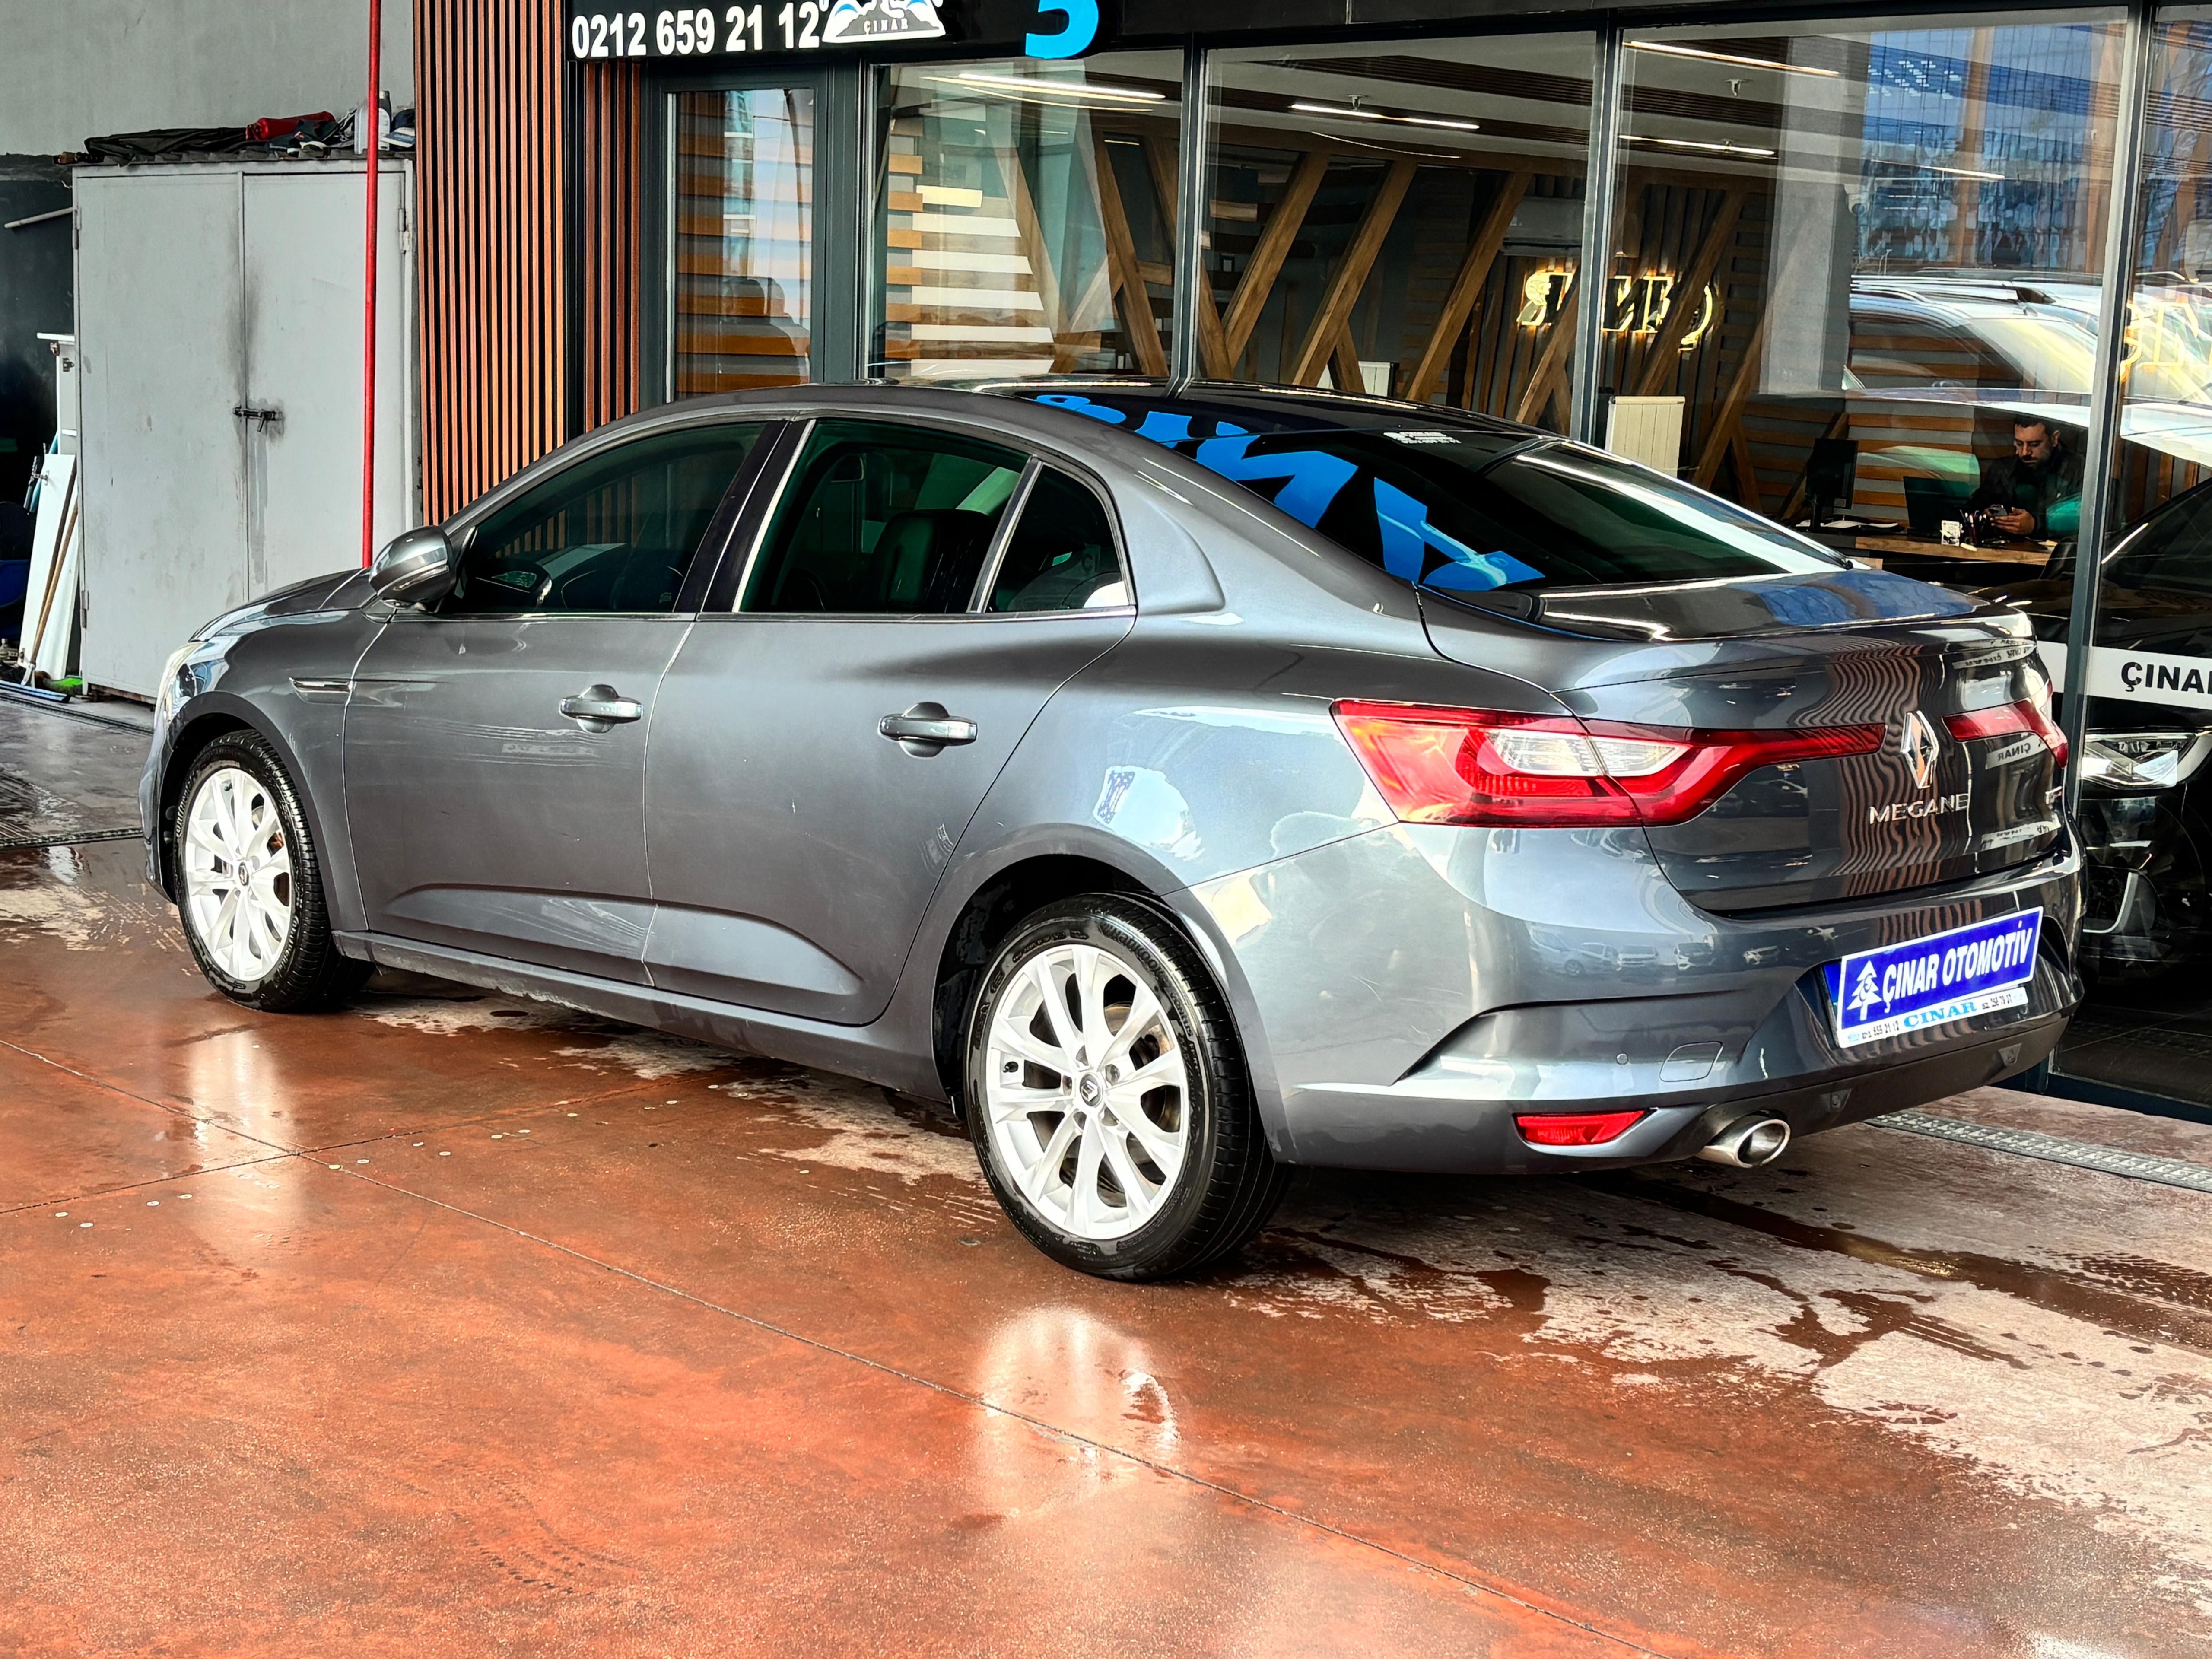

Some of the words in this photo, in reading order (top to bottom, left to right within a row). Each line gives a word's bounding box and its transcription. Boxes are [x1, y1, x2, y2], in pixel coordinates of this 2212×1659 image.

[572, 13, 646, 59] 0212
[656, 8, 715, 55] 659
[725, 6, 763, 51] 21
[779, 1, 820, 48] 12
[864, 18, 908, 35] ÇINAR
[2121, 661, 2212, 695] ÇINA
[1869, 793, 1970, 824] MEGANE
[1882, 954, 1939, 1014] ÇINAR
[1942, 920, 2033, 986] OTOMOTİV
[1904, 1001, 1977, 1029] ÇINAR
